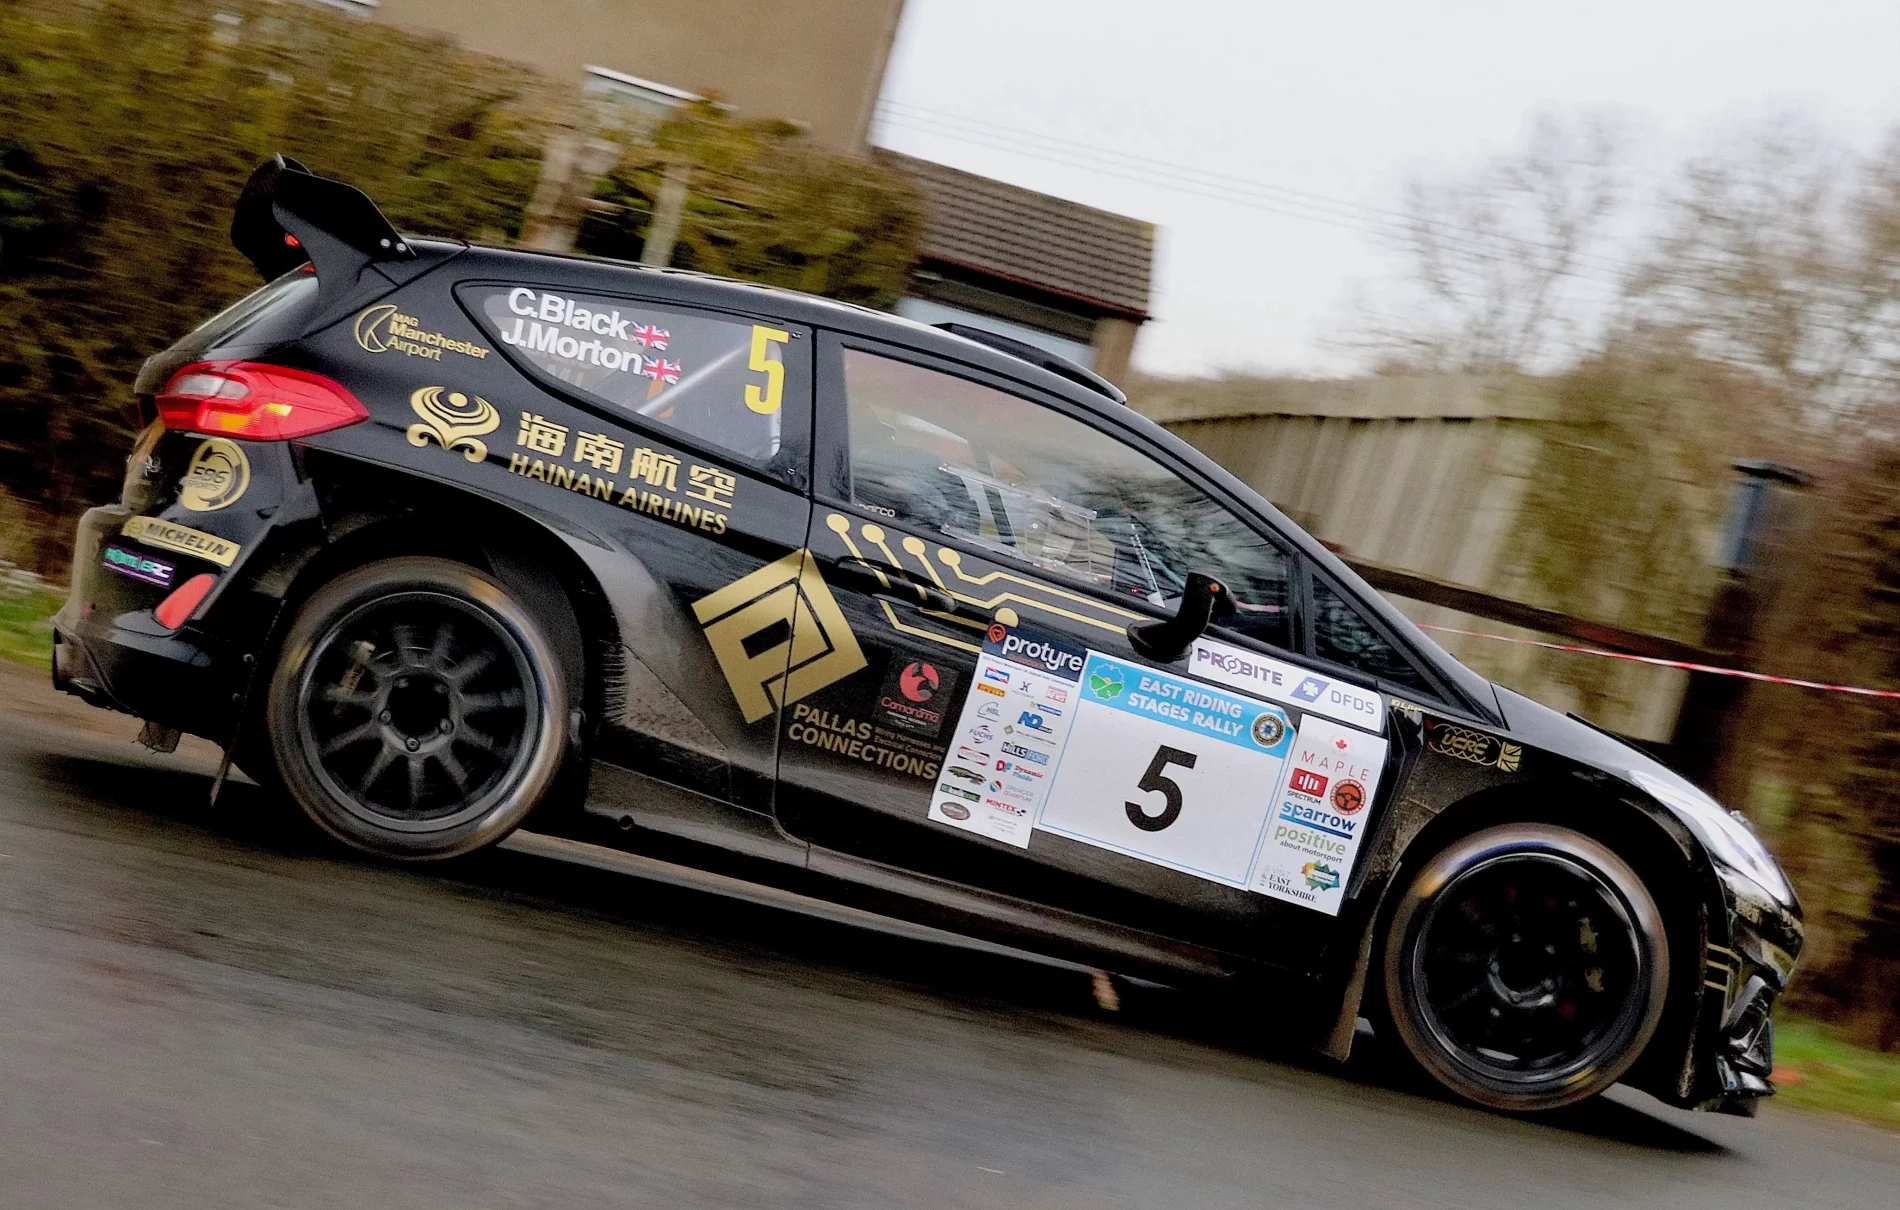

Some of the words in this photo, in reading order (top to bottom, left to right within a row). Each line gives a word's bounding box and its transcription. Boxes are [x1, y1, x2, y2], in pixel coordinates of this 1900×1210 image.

[393, 313, 419, 327] MAG
[508, 287, 631, 341] C.Black
[386, 337, 442, 361] Airport
[389, 322, 490, 359] Manchester
[502, 319, 644, 375] J.Morton
[744, 324, 789, 415] 5
[516, 411, 736, 509] 海南航空
[508, 452, 614, 501] HAINAN
[620, 486, 728, 535] AIRLINES
[146, 523, 229, 557] MICHELIN
[1002, 634, 1083, 671] protyre
[1197, 646, 1283, 687] PROBITE
[1139, 676, 1182, 702] EAST
[1182, 687, 1243, 718] RIDING
[1330, 689, 1376, 715] DFDS
[793, 704, 872, 740] PALLAS
[1127, 693, 1190, 723] STAGES
[1191, 710, 1244, 737] RALLY
[969, 728, 994, 741] FUCHS
[788, 724, 940, 780] CONNECTIONS
[1301, 750, 1369, 781] MAPLE
[1014, 764, 1044, 779] Dynamic
[1124, 744, 1197, 833] 5
[986, 798, 1017, 813] MINTEX
[1287, 790, 1321, 805] SPECTRUM
[1281, 801, 1357, 832] sparrow
[1273, 823, 1346, 856] positive
[1279, 839, 1301, 852] about
[1302, 846, 1342, 864] motorsport
[1267, 881, 1318, 903] YORKSHIRE
[1269, 873, 1292, 886] EAST
